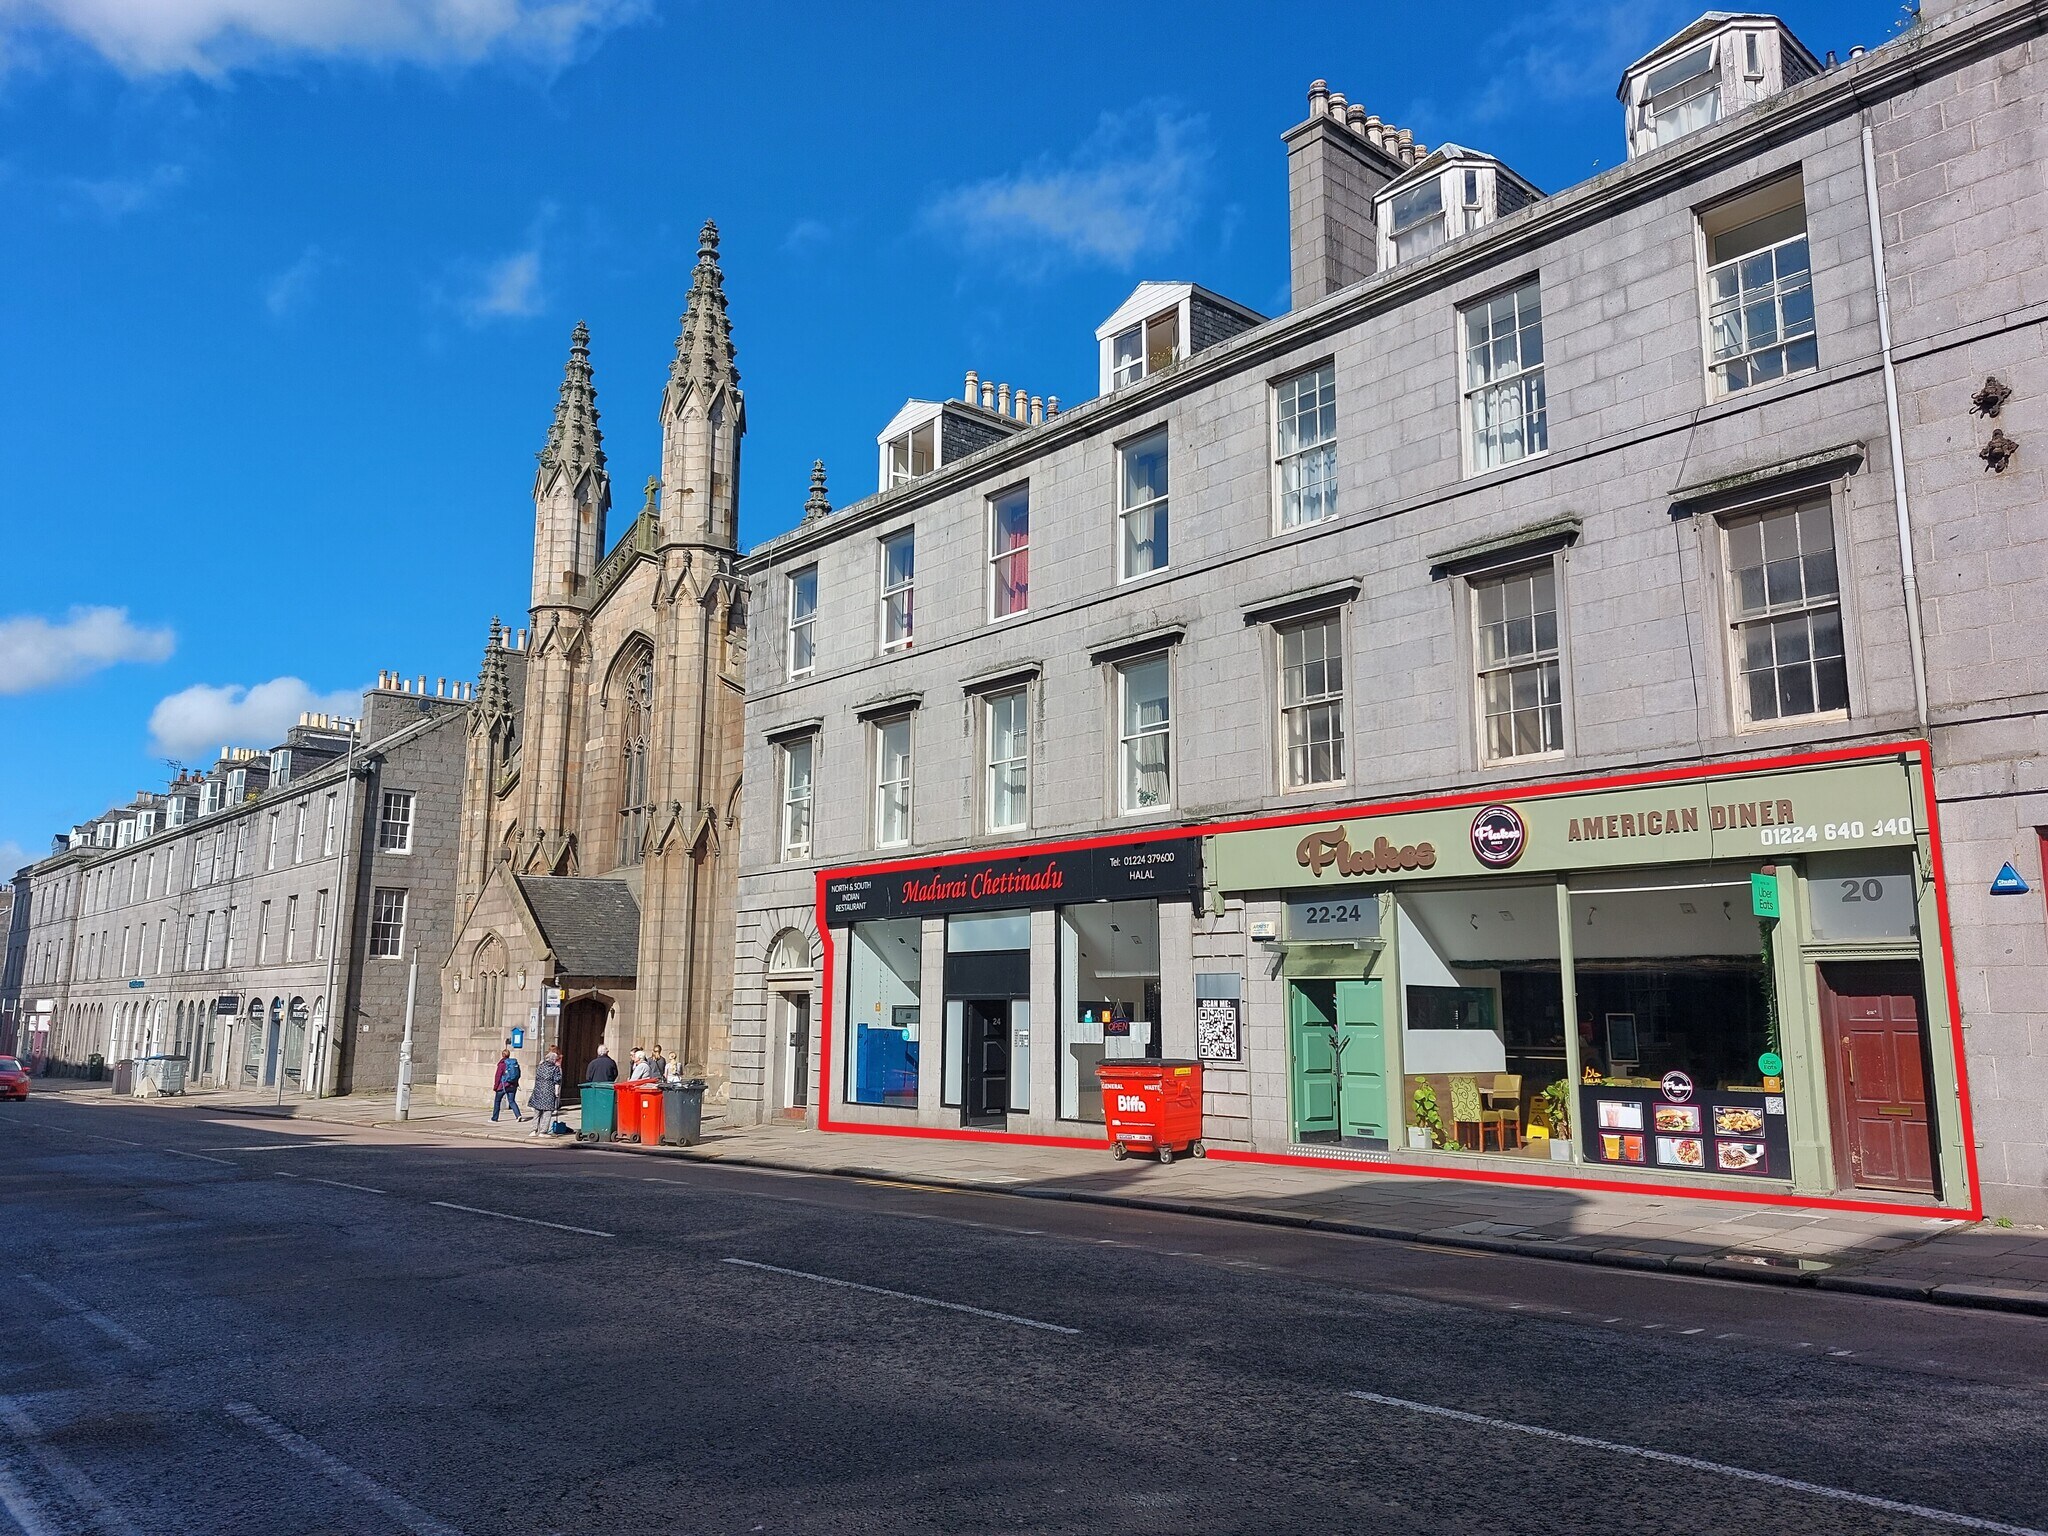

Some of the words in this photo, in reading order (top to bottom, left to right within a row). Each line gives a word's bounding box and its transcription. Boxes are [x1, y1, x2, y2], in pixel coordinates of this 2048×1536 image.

[1568, 807, 1699, 842] AMERICAN
[1711, 799, 1795, 831] DINER
[1760, 825, 1818, 846] 01224
[1824, 821, 1865, 841] 640
[1296, 825, 1437, 878] Flakes
[1109, 857, 1121, 867] Tel:
[1123, 855, 1146, 866] 01224
[1147, 852, 1175, 864] 379600
[1129, 869, 1155, 880] HALAL
[831, 883, 849, 893] NORTH
[854, 881, 872, 891] SOUTH
[902, 874, 968, 904] Madurai
[970, 861, 1064, 900] Chettinadu
[1758, 886, 1773, 898] Uber
[1840, 878, 1884, 903] 20
[841, 892, 860, 902] INDIAN
[835, 901, 867, 912] RESTAURANT
[1759, 899, 1774, 910] Eats
[1306, 904, 1361, 924] 22-24
[1202, 1000, 1218, 1008] SCAN
[1219, 1000, 1231, 1008] ME:
[992, 1017, 1001, 1026] 24
[1108, 1021, 1128, 1032] OPEN
[1117, 1095, 1146, 1112] Biffa
